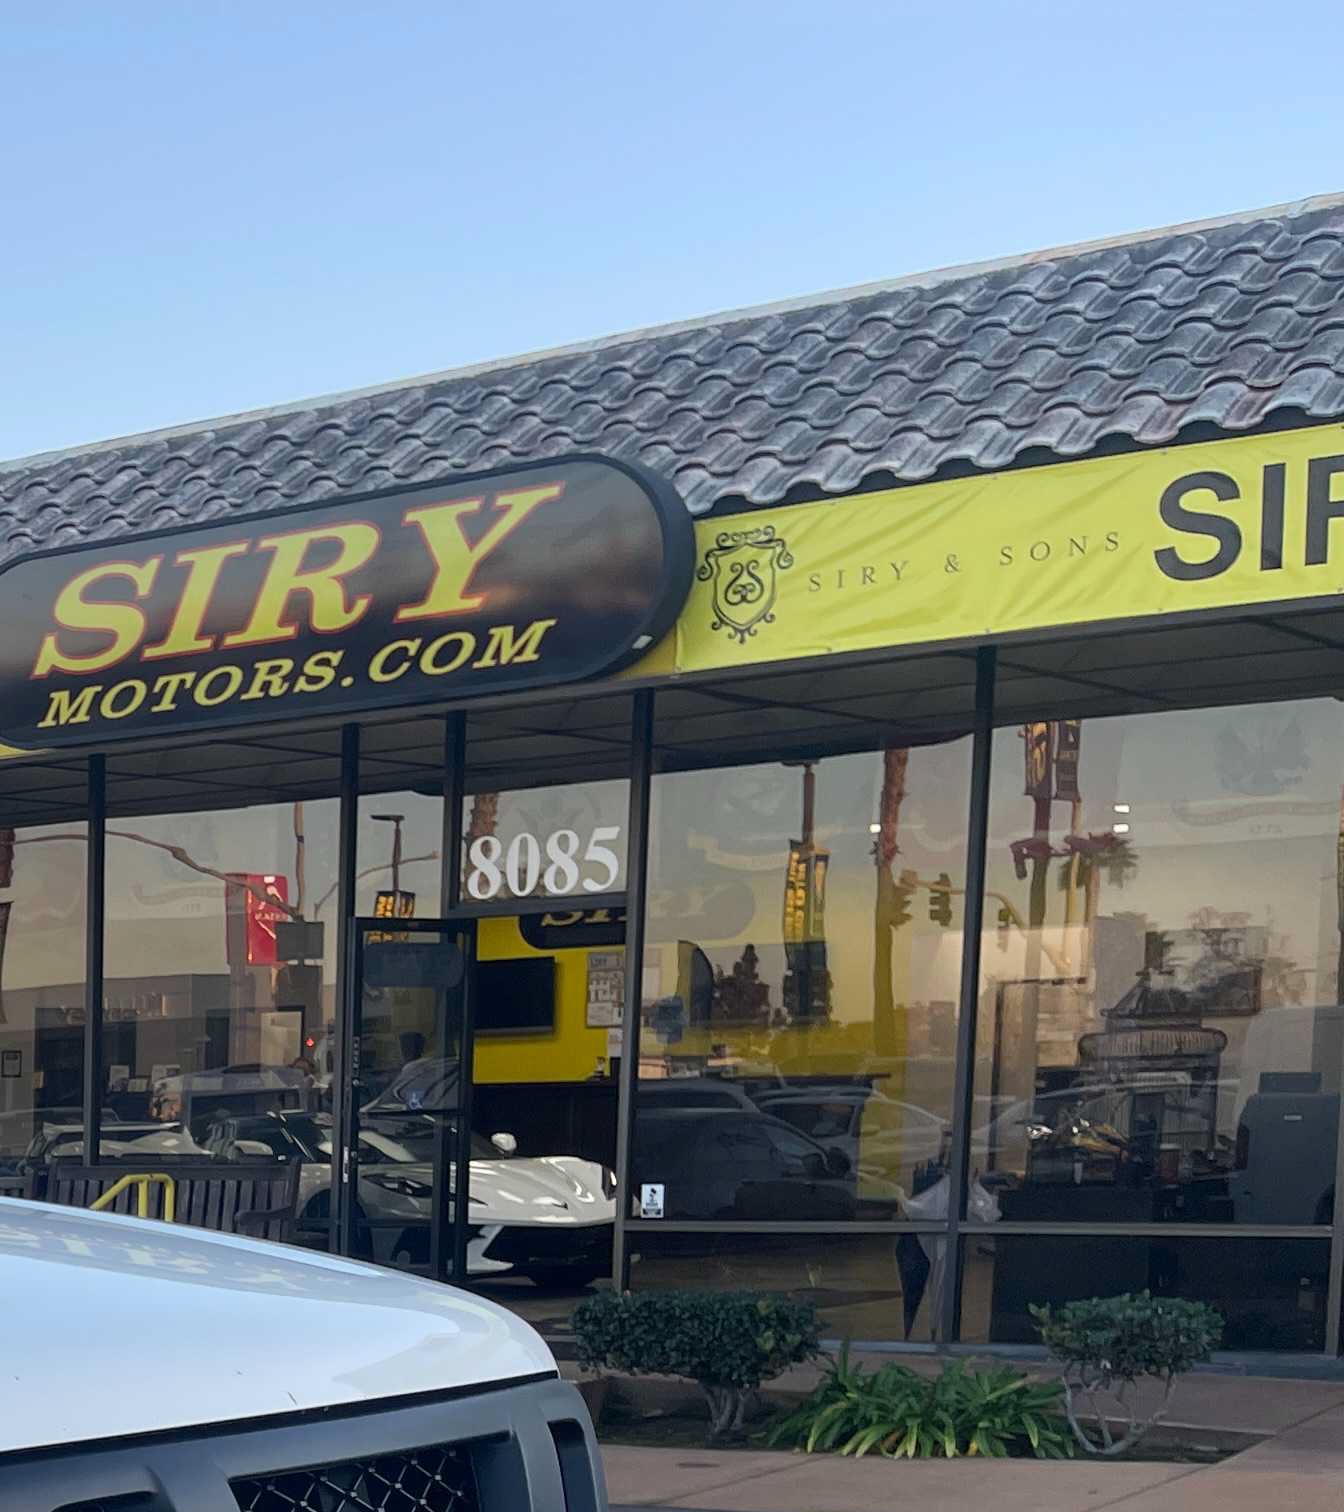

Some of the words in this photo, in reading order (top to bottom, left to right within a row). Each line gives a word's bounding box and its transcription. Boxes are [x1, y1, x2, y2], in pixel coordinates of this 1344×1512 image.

[31, 481, 566, 679] SIRY
[808, 557, 911, 592] SIRY
[943, 552, 962, 573] &
[998, 530, 1121, 567] SONS
[468, 827, 621, 901] 8085
